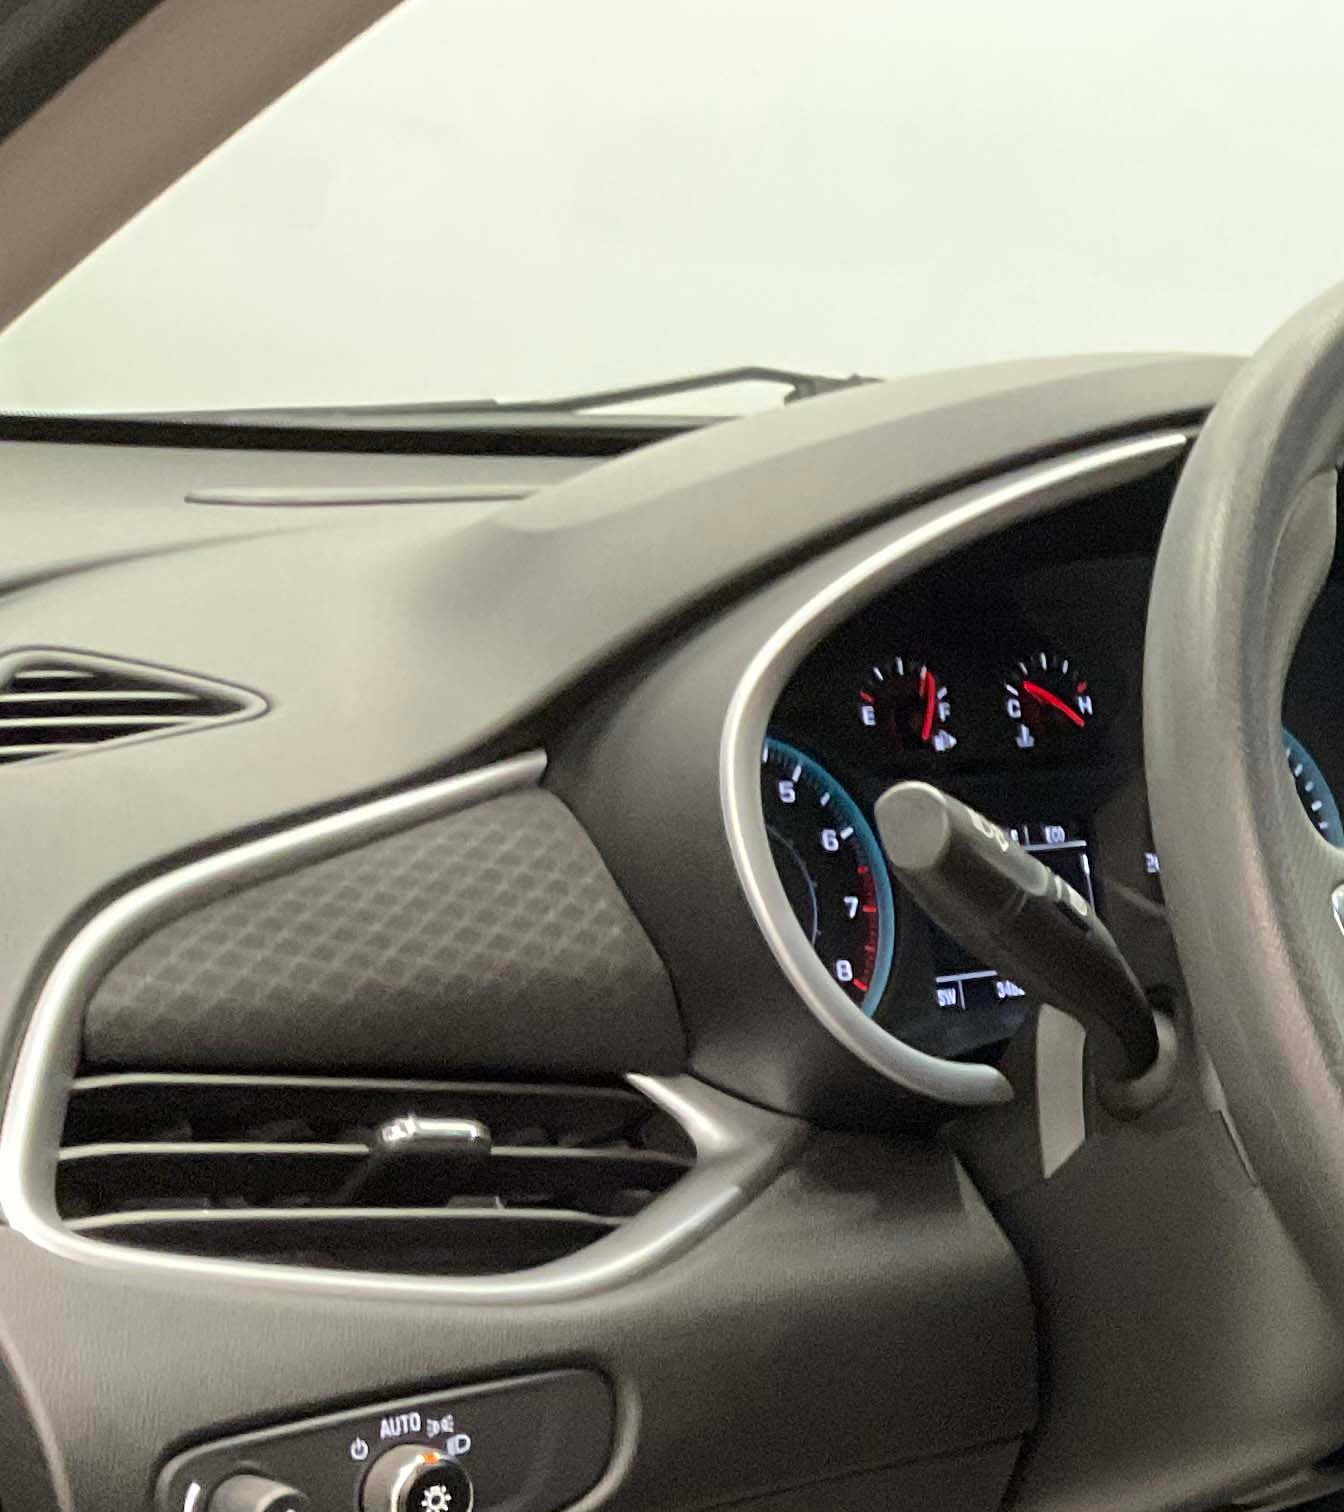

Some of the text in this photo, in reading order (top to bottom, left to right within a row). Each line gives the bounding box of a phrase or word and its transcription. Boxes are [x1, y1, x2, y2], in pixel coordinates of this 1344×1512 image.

[862, 705, 876, 726] E
[938, 701, 951, 722] F
[1077, 695, 1093, 715] H
[778, 780, 796, 804] 5
[821, 828, 840, 852] 6
[843, 896, 859, 919] 7
[835, 959, 853, 982] 8
[380, 1412, 421, 1440] AUTO
